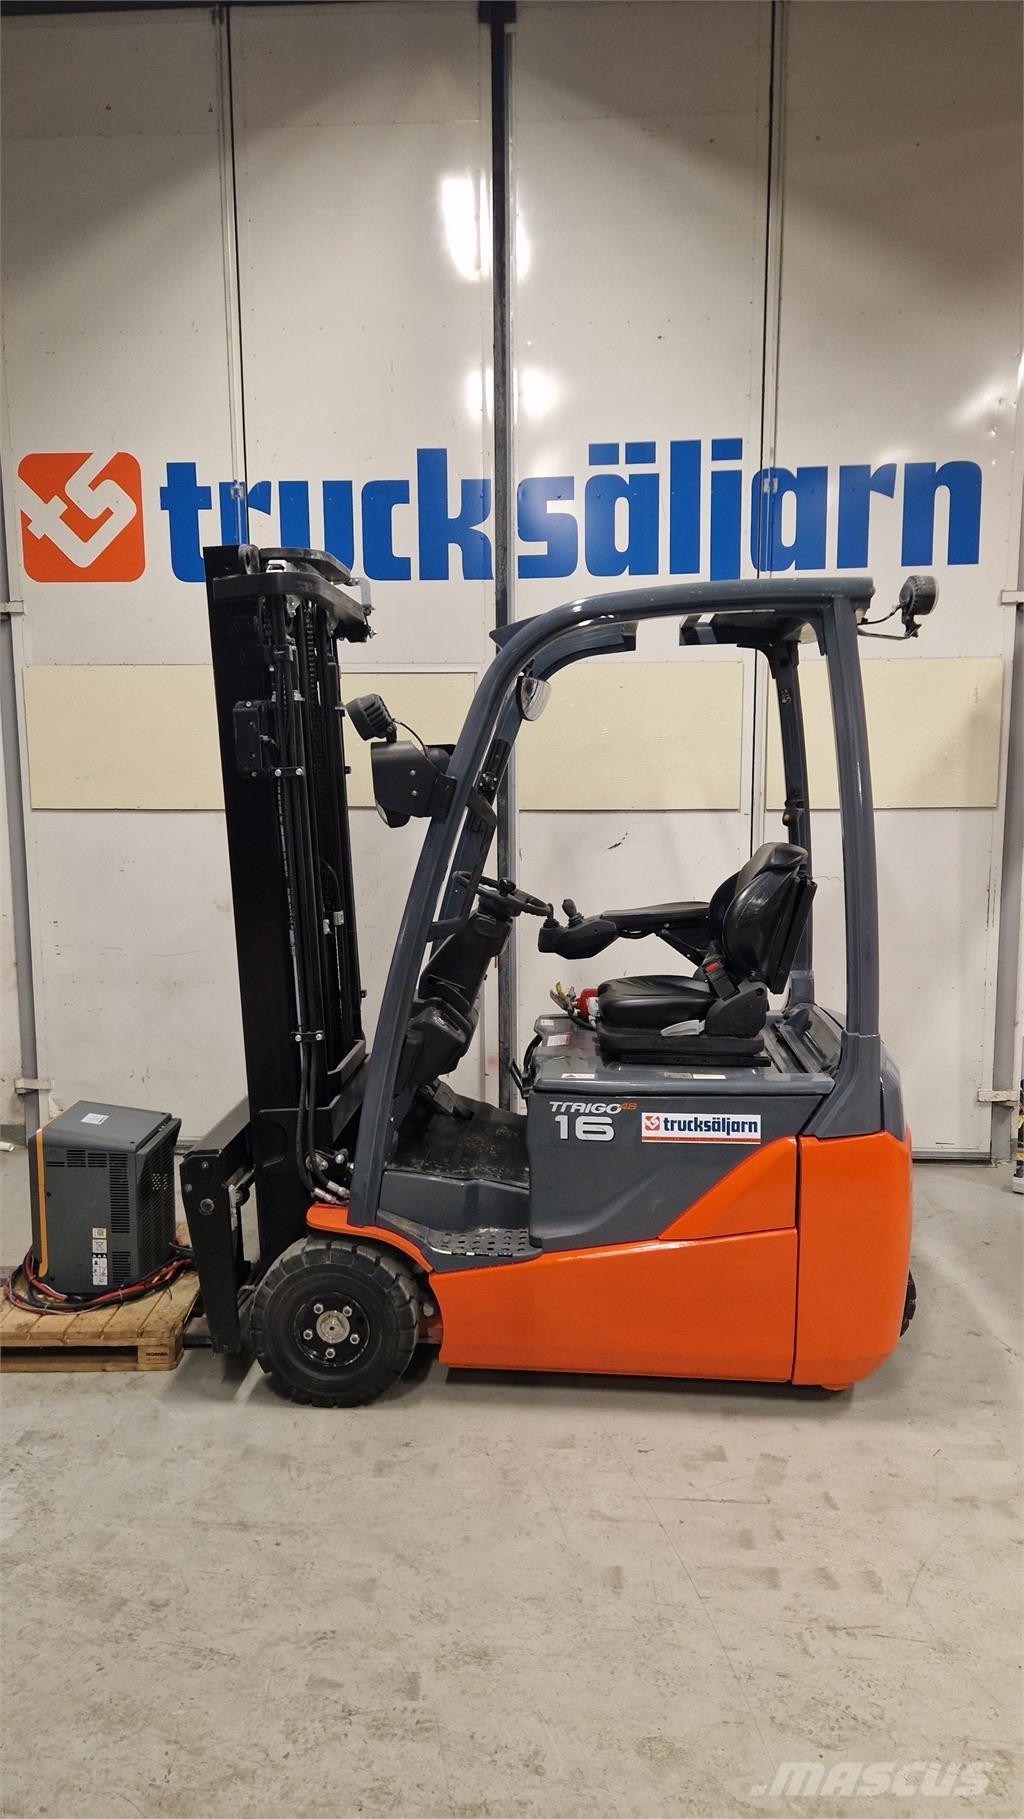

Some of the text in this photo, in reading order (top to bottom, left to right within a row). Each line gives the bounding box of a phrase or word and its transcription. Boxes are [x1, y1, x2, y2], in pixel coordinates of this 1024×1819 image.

[160, 437, 982, 582] trucksäljarn
[554, 1114, 615, 1141] 16
[663, 1117, 758, 1136] trucksäljarn
